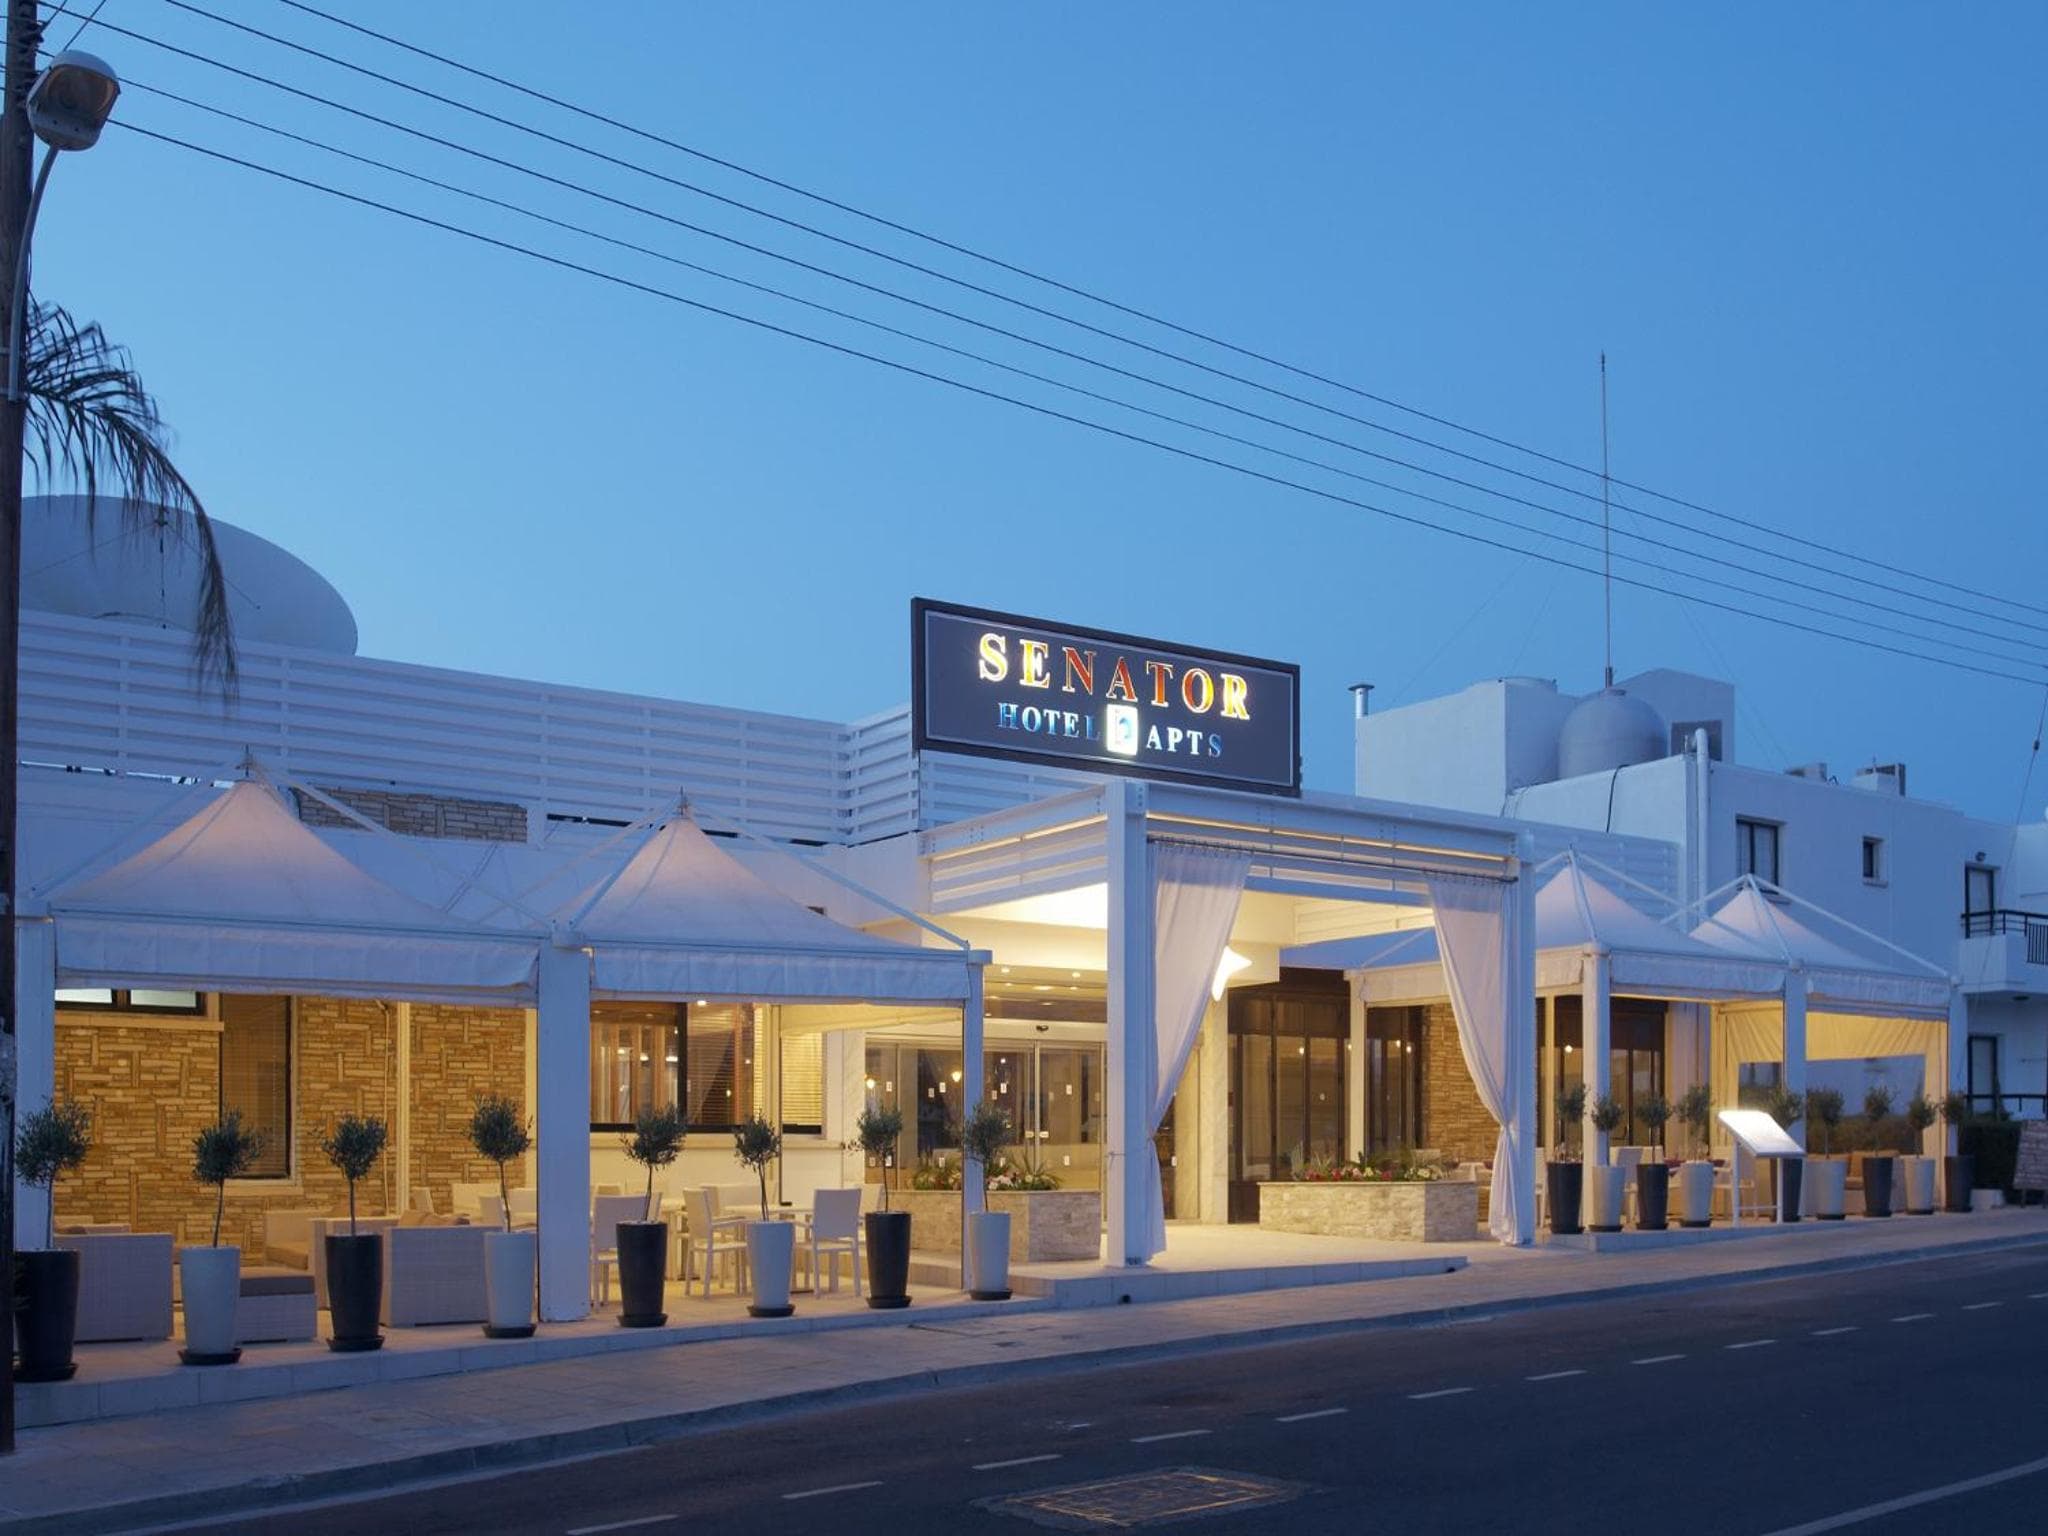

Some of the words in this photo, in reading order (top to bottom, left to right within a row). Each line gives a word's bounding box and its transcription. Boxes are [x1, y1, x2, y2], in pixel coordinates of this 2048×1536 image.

[978, 632, 1251, 721] SENATOR
[997, 702, 1101, 741] HOTEL
[1145, 724, 1222, 758] APTS
